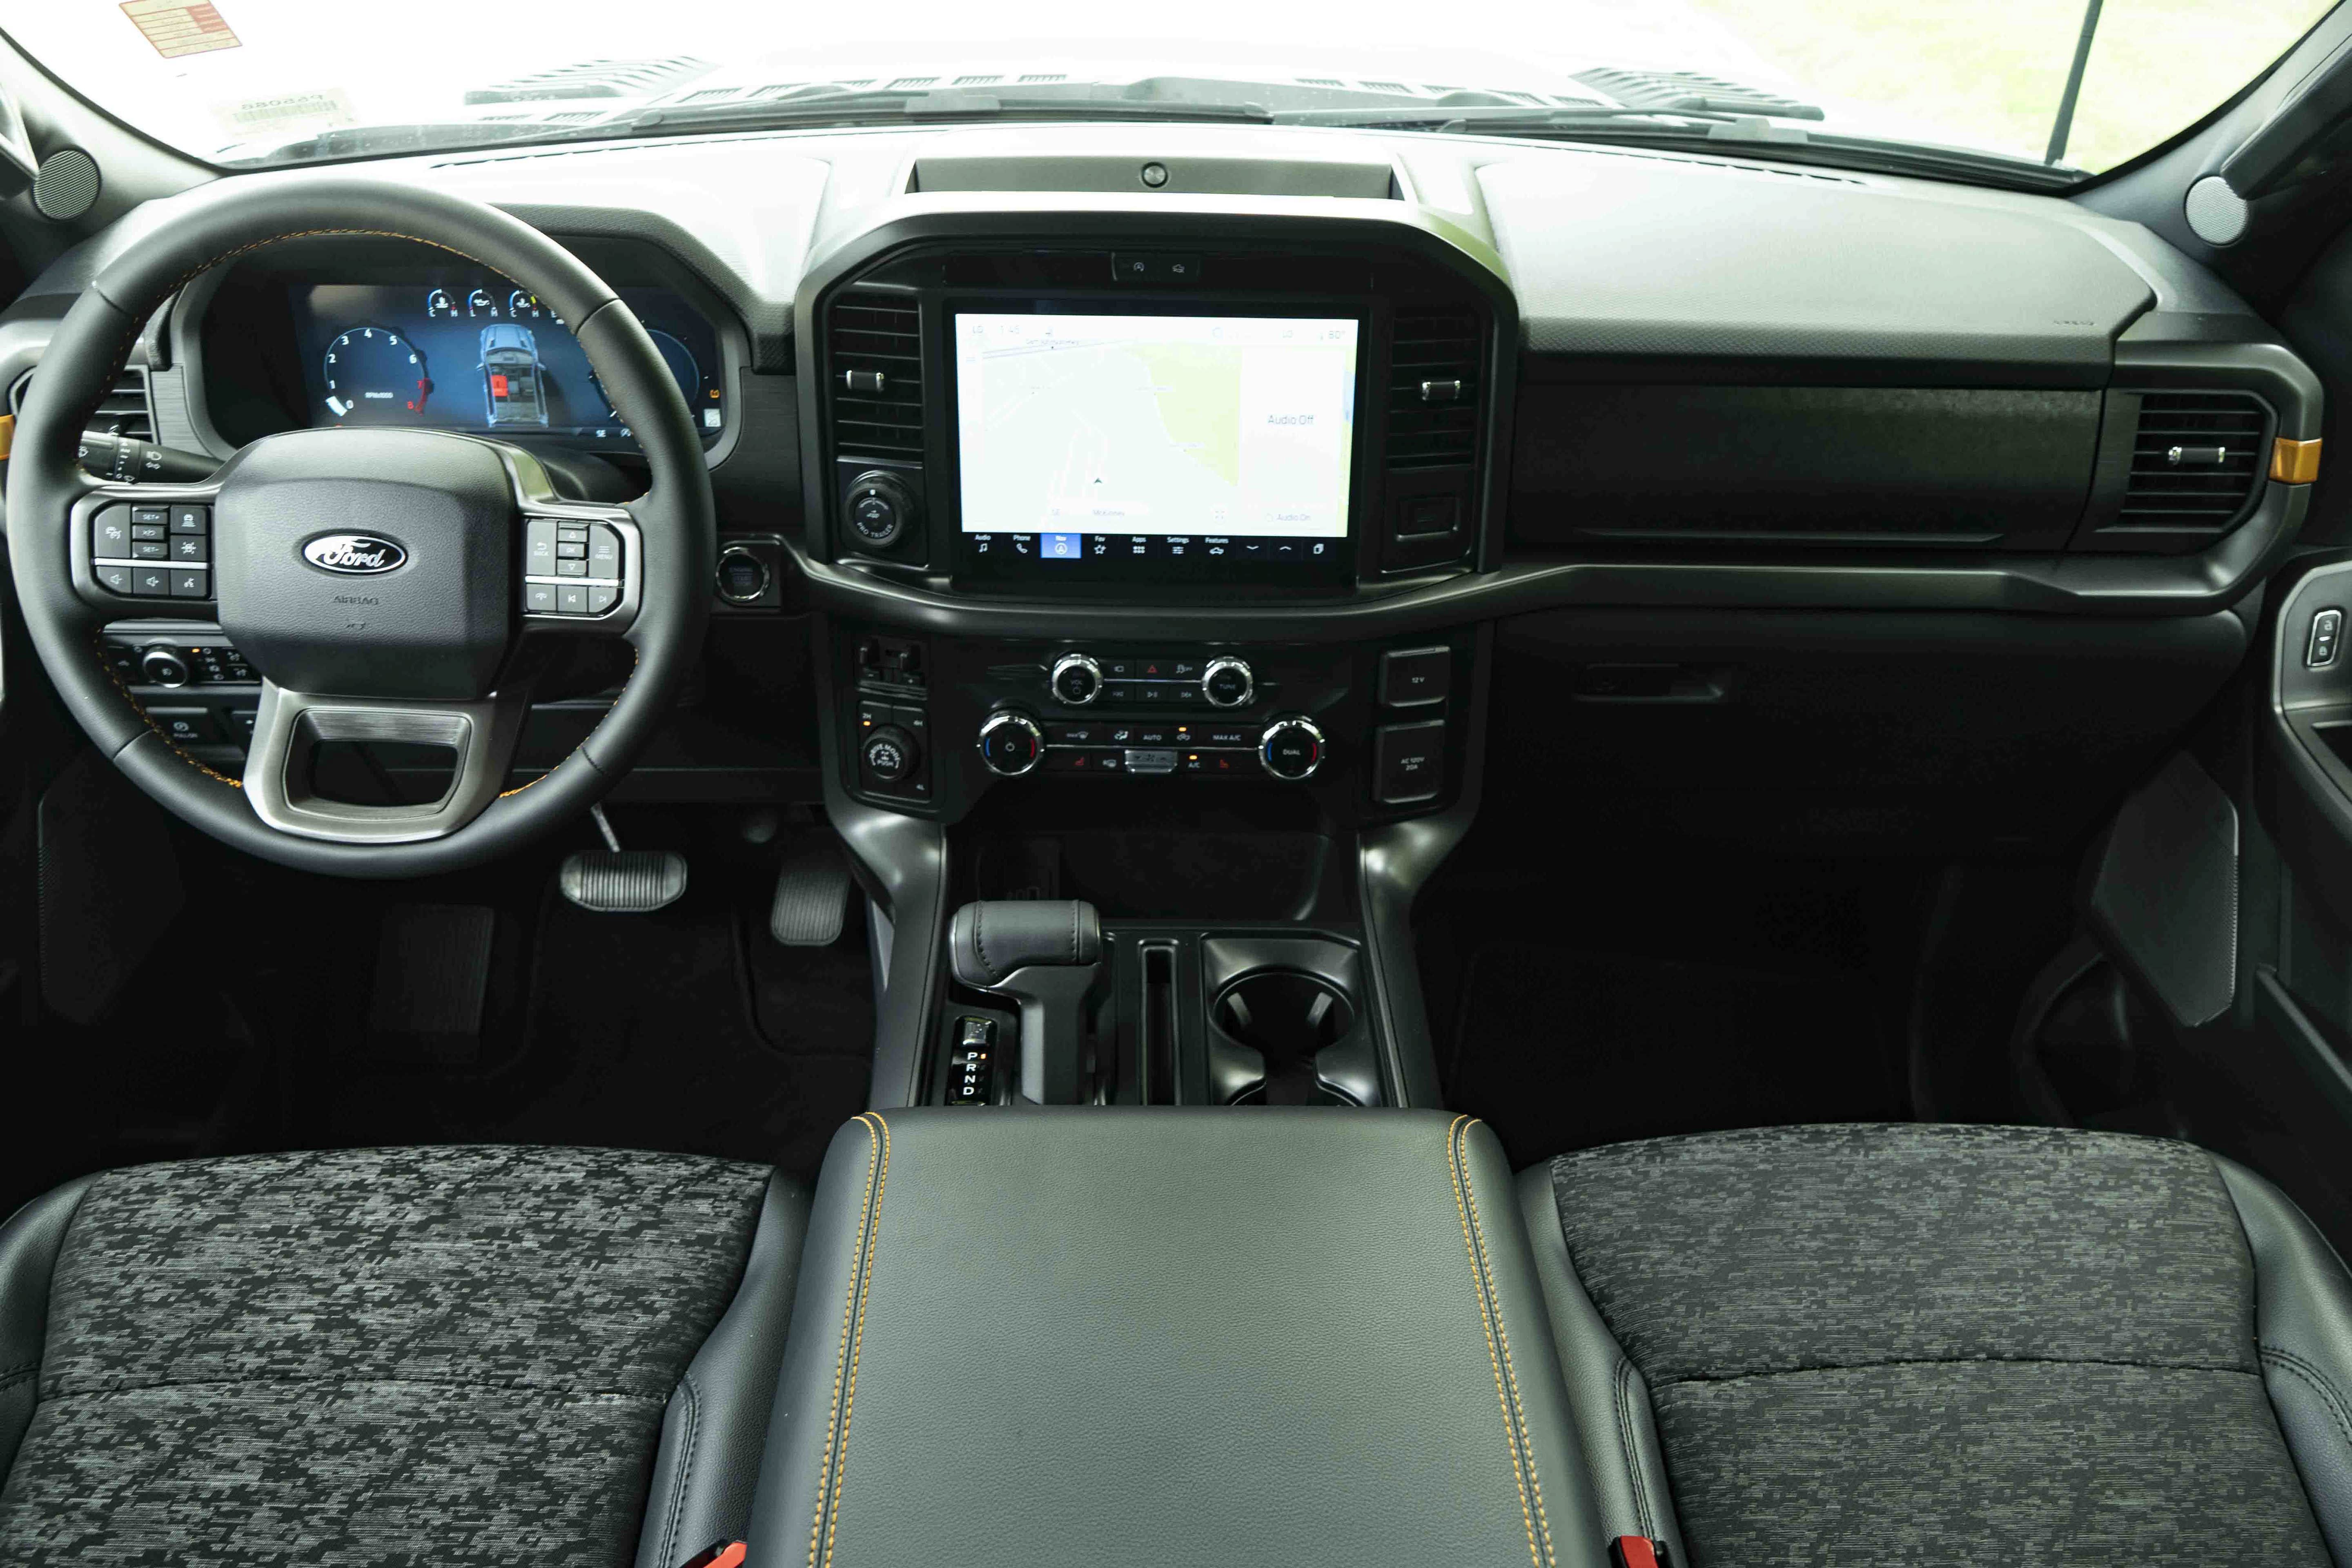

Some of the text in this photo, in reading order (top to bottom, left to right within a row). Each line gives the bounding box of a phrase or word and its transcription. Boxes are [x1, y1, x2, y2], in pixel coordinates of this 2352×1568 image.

[450, 309, 458, 317] H
[532, 309, 539, 317] H
[363, 328, 372, 339] 4
[341, 335, 349, 345] 3
[389, 335, 398, 345] 5
[328, 353, 336, 363] 2
[408, 354, 417, 364] 6
[329, 380, 335, 389] 1
[416, 380, 423, 389] 7
[345, 400, 354, 410] 0
[407, 401, 414, 409] 8
[1267, 414, 1314, 425] Audio Off
[1276, 513, 1299, 522] Audio
[320, 541, 386, 568] Ford
[332, 595, 380, 605] AIRBAG
[967, 1052, 978, 1060] P
[966, 1063, 977, 1072] R
[964, 1075, 976, 1083] N
[962, 1087, 974, 1095] D
